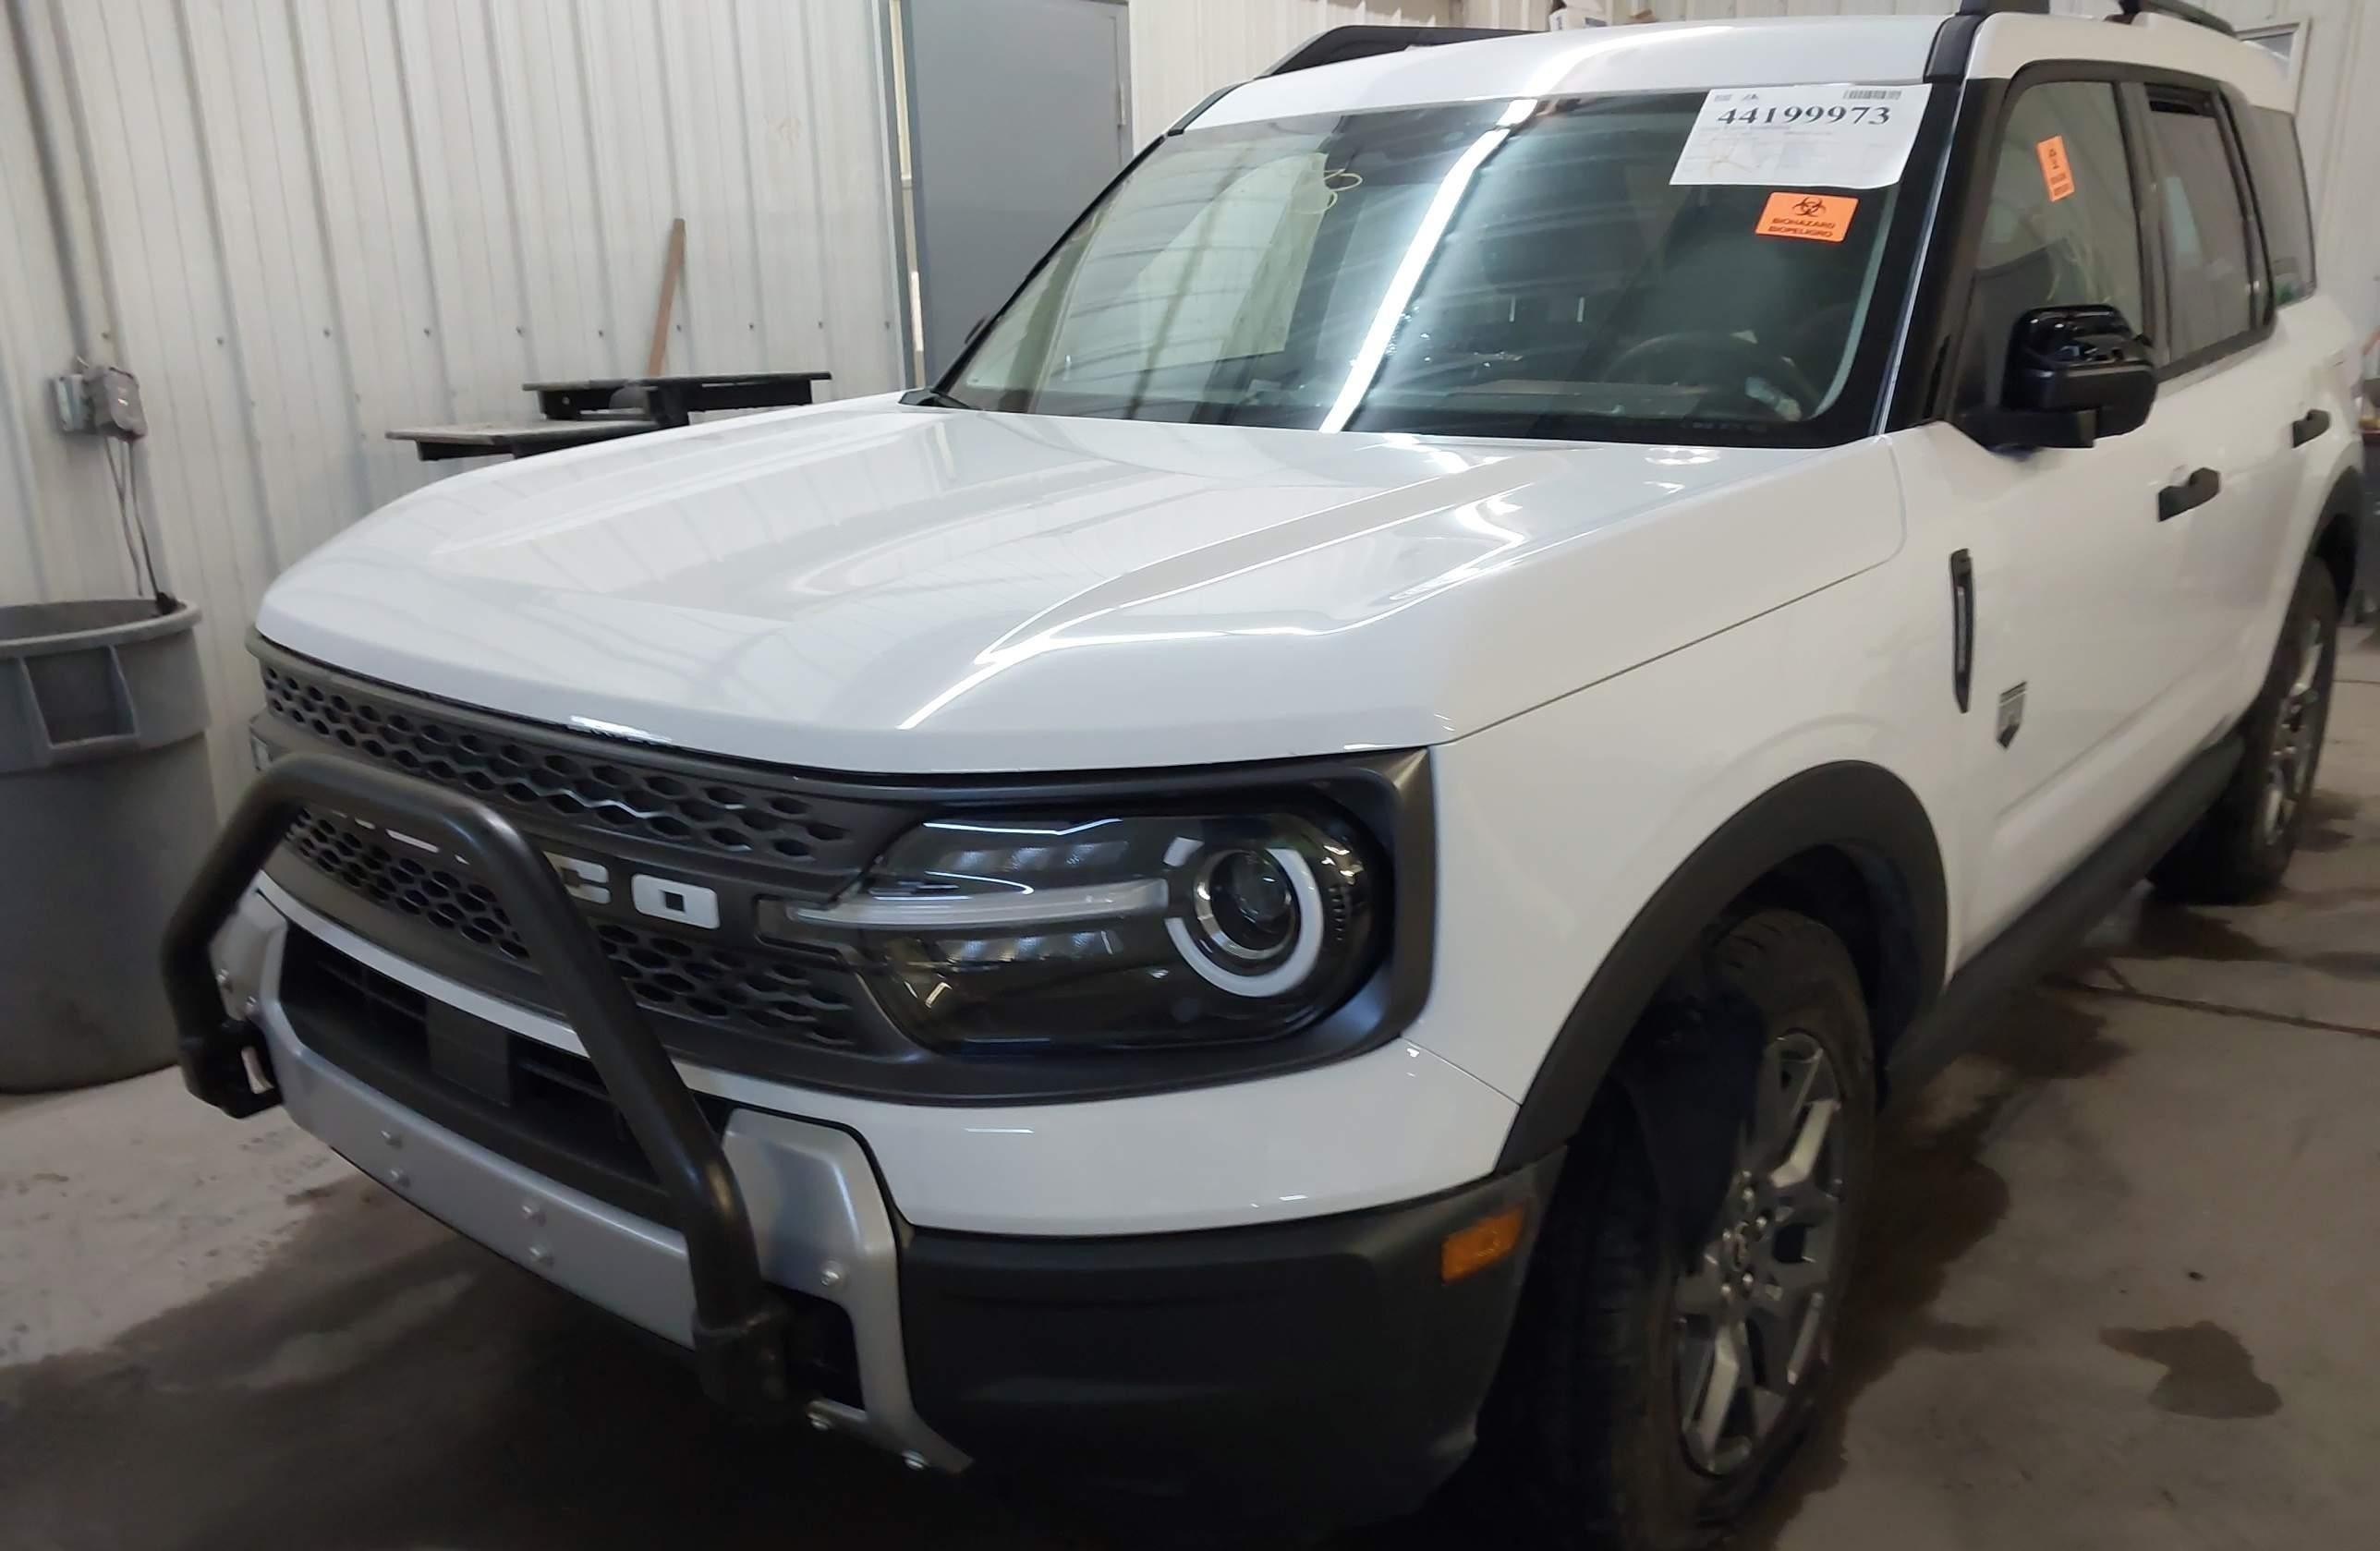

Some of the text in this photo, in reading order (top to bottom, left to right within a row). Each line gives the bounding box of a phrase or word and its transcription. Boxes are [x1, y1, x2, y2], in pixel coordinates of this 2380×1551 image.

[1718, 105, 1890, 126] 44199973
[1772, 218, 1836, 229] BIOHAZARD
[1767, 226, 1834, 237] BIOPELIGRO
